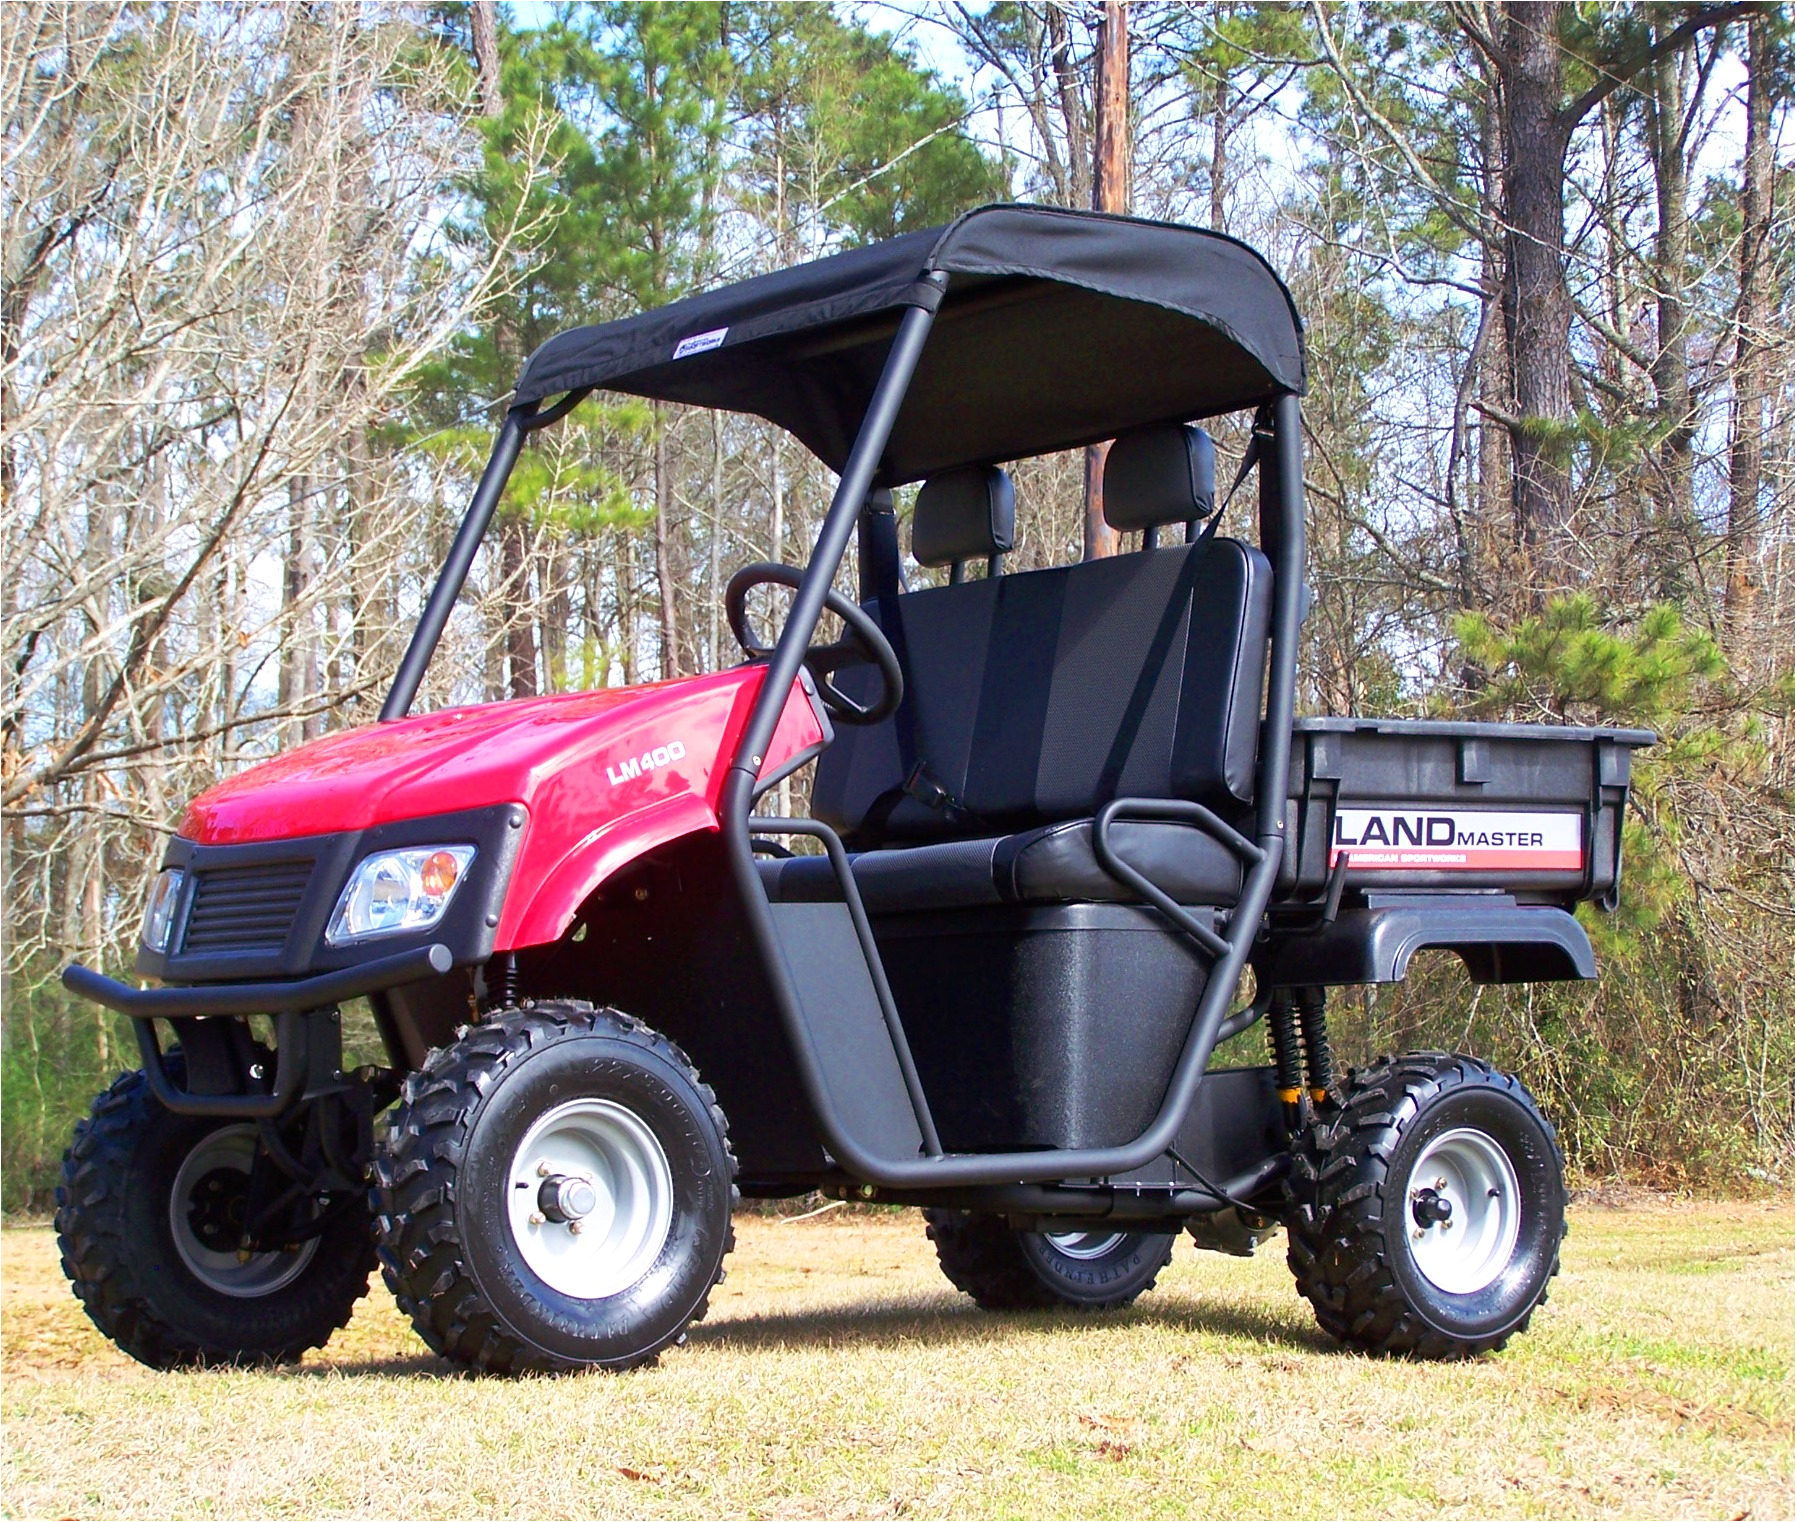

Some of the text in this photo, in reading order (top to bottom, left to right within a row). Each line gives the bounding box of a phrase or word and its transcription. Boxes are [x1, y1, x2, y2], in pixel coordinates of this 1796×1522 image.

[606, 741, 686, 786] LM400
[1335, 816, 1544, 847] LAND MASTER
[1348, 853, 1399, 863] AMERICAN
[1401, 853, 1467, 863] SPORTWORKS
[1039, 1244, 1142, 1284] PATHFINDER
